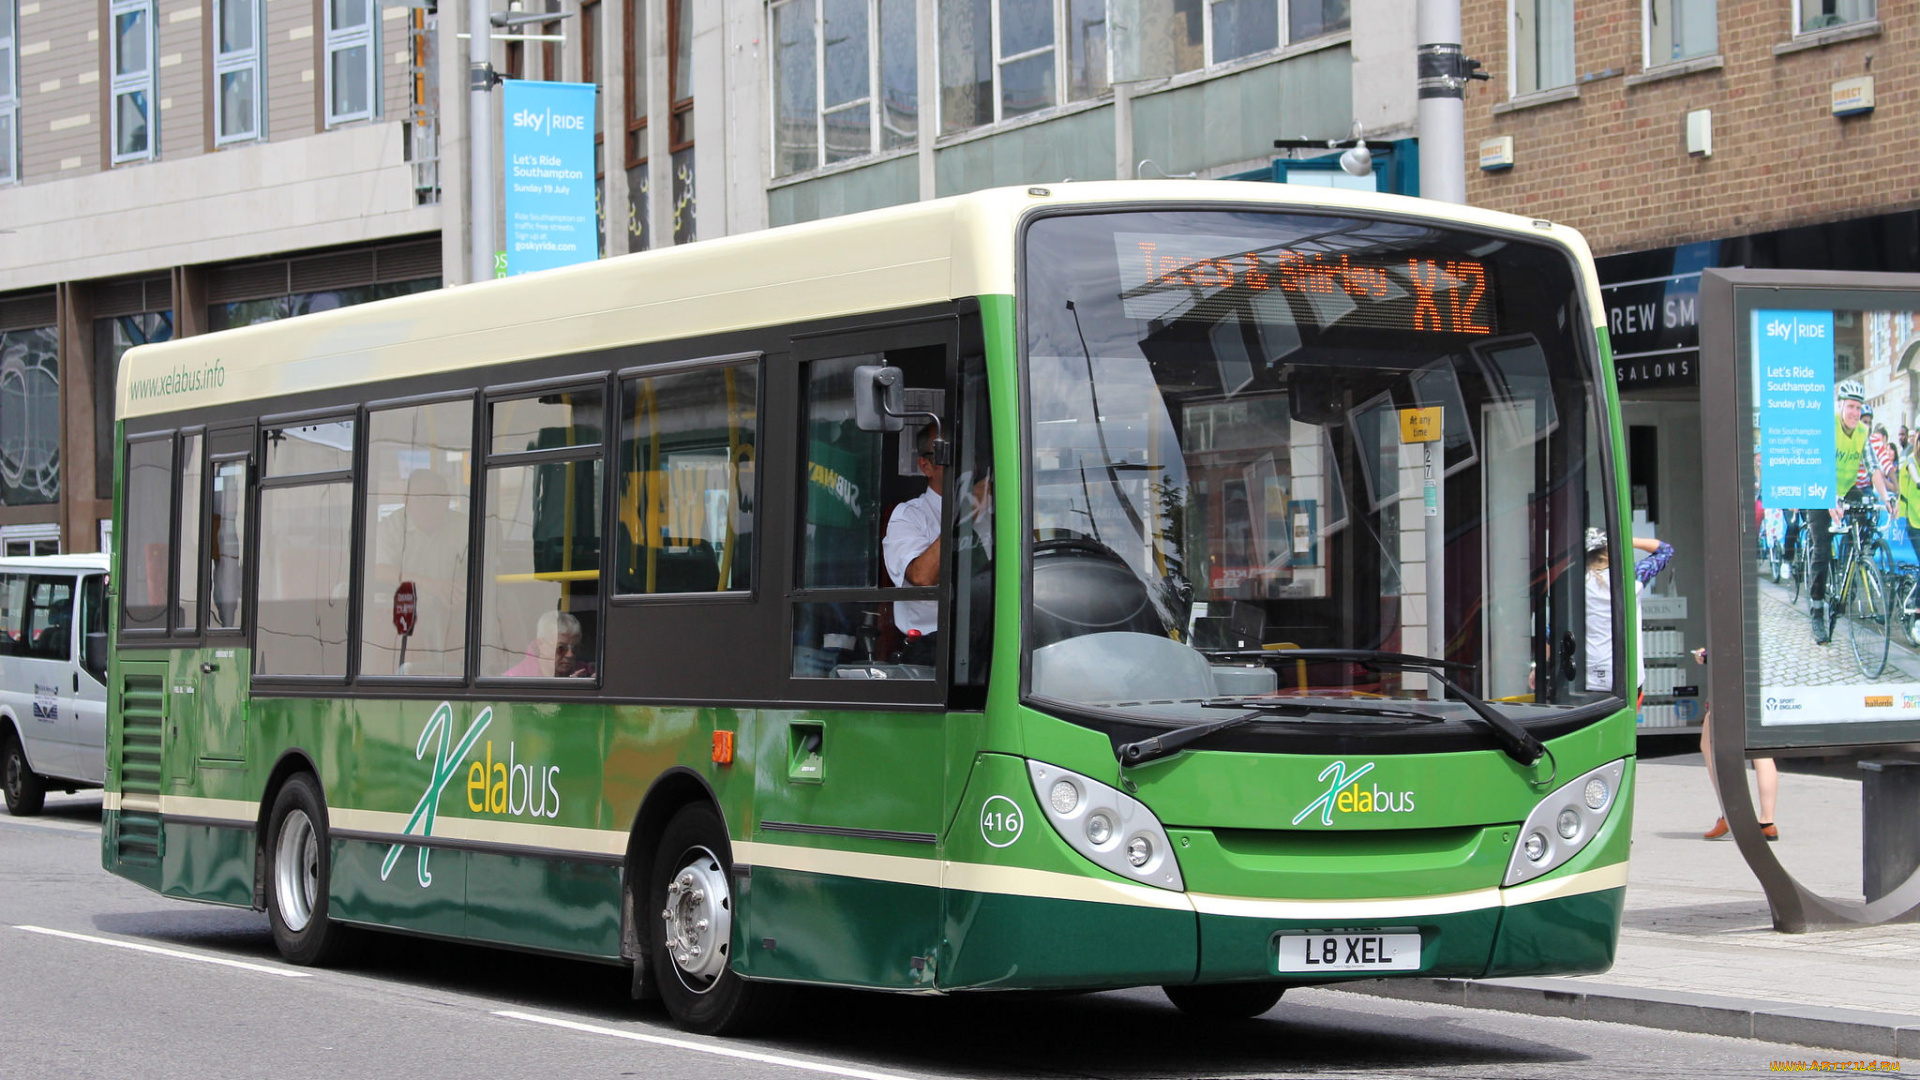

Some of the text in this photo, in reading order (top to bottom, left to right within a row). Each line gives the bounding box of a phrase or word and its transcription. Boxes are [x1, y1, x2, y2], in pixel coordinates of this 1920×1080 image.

[513, 109, 584, 131] sky RIDE
[513, 154, 562, 166] Let's Ride
[513, 166, 583, 180] Southampton
[513, 183, 570, 196] Sunday 19 July
[515, 241, 576, 252] goskyride.com
[1244, 252, 1271, 290] &
[1278, 250, 1387, 298] Shirley
[1408, 258, 1490, 334] X12
[1766, 319, 1826, 341] sky RIDE
[1617, 360, 1689, 382] SALONS
[1767, 366, 1815, 379] Let's Ride
[130, 357, 225, 401] www.xelabus.info
[1767, 381, 1826, 394] Southampton
[1768, 398, 1822, 411] Sunday 19 July
[1419, 415, 1432, 427] any
[1413, 427, 1428, 438] time
[1769, 456, 1822, 467] goskyride.com
[1808, 483, 1828, 499] sky
[1865, 699, 1894, 708] halfords
[381, 700, 561, 888] Xelabus
[1292, 760, 1415, 826] Xelabus
[983, 812, 1019, 832] 416
[1305, 937, 1393, 964] L8 XEL
